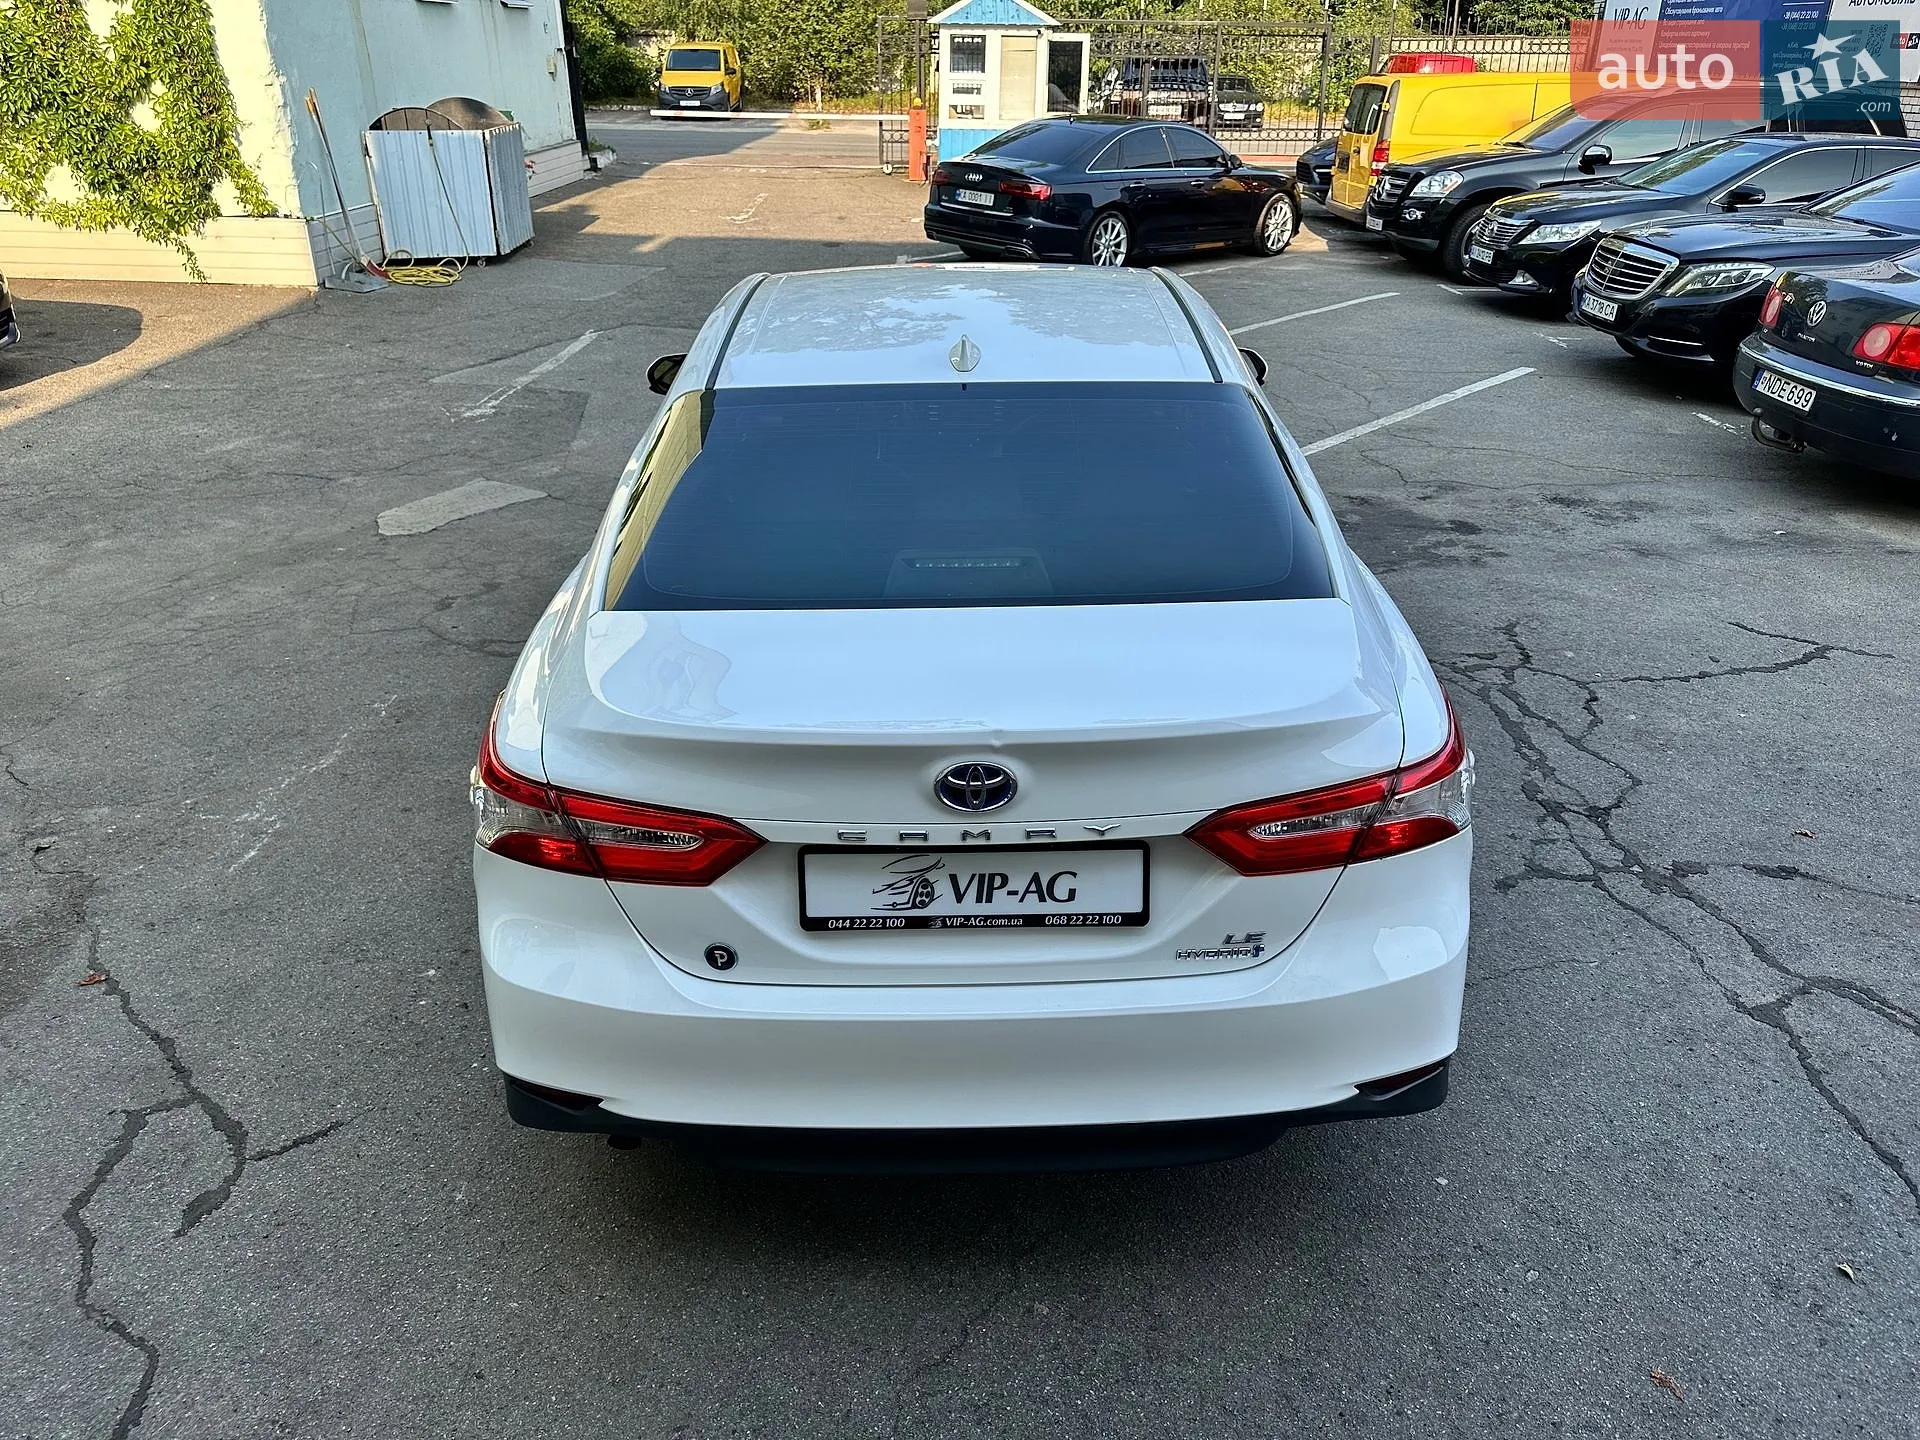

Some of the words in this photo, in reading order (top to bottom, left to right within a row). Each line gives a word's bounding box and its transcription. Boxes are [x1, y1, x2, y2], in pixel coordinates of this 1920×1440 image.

[1613, 6, 1649, 30] VIP-AG
[1763, 373, 1791, 399] NDE
[1786, 385, 1813, 408] 699
[837, 823, 1121, 841] CAMRY
[948, 870, 1078, 904] VIP-AG
[828, 918, 851, 929] 044
[853, 918, 868, 928] 22
[870, 917, 884, 928] 22
[886, 917, 905, 928] 100
[946, 916, 1023, 927] VIP-AG.com.ua
[1045, 915, 1067, 925] 068
[1069, 915, 1084, 925] 22
[1085, 915, 1100, 925] 22
[1102, 914, 1122, 925] 100
[1222, 931, 1267, 944] LE
[1176, 946, 1252, 960] HYBRID
